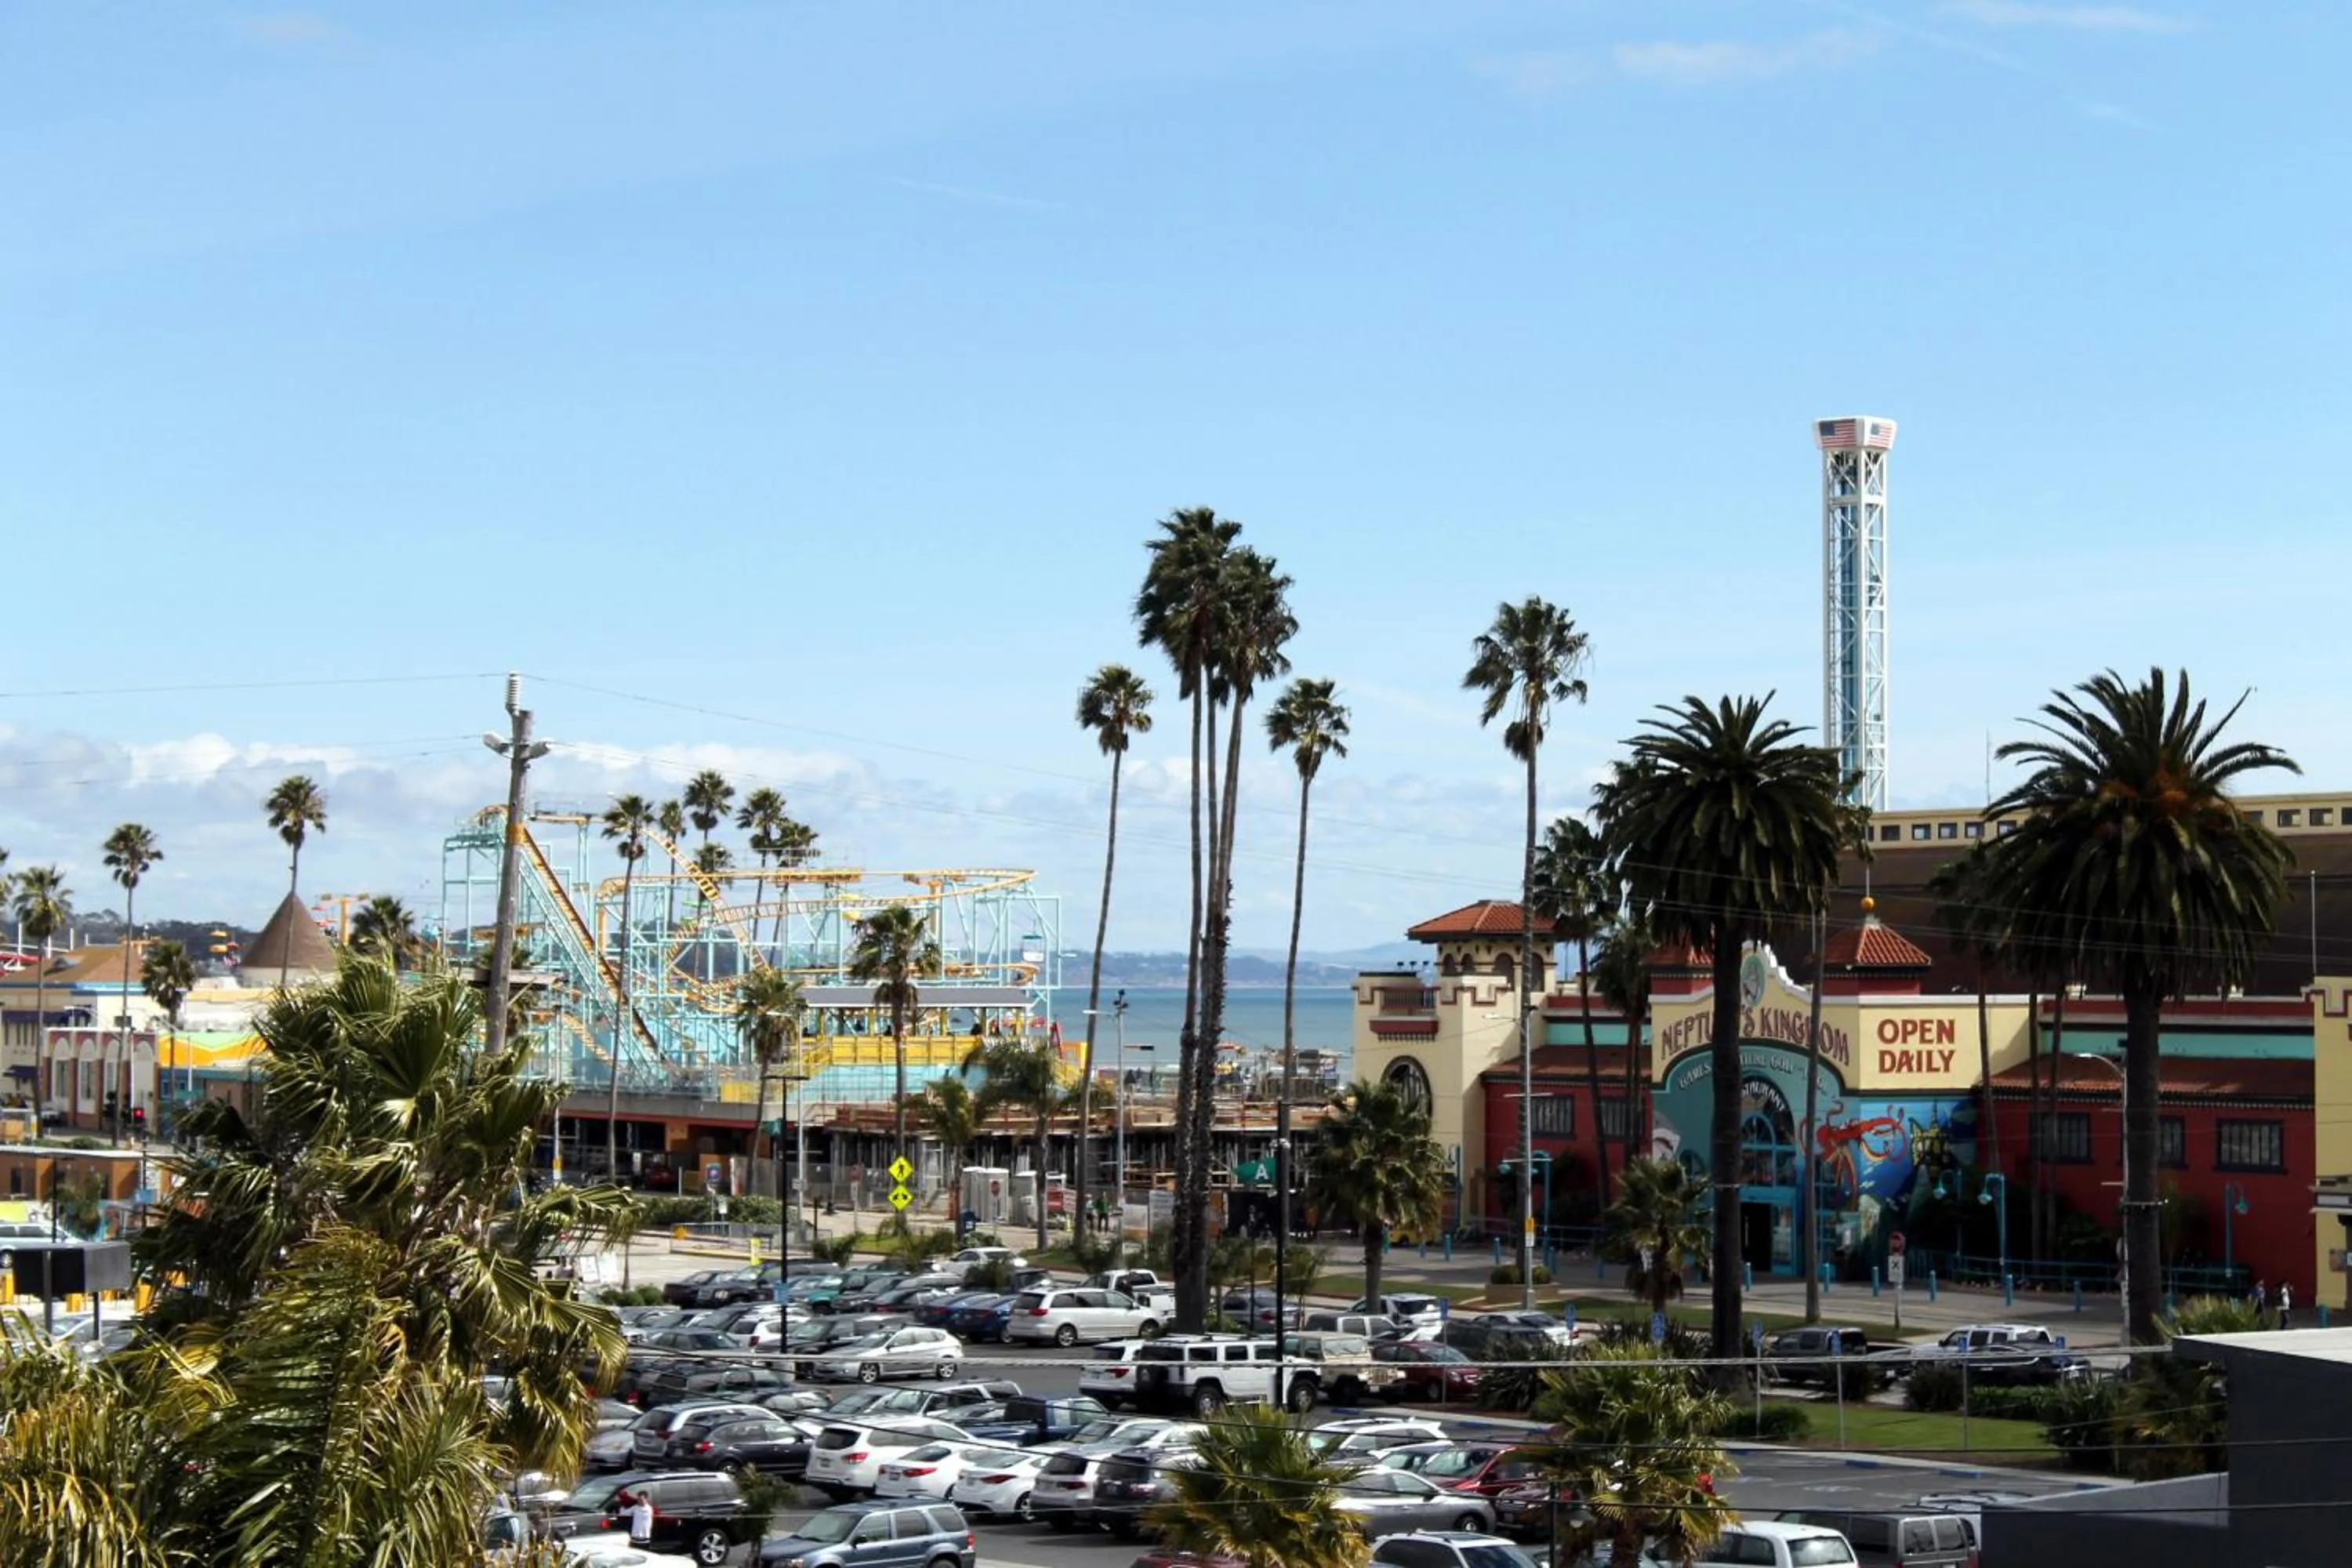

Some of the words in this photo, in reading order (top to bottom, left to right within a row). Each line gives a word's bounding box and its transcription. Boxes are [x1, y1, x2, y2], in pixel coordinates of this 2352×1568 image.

[1878, 1018, 1955, 1044] OPEN
[1878, 1050, 1957, 1073] DAILY
[1255, 1163, 1269, 1180] A
